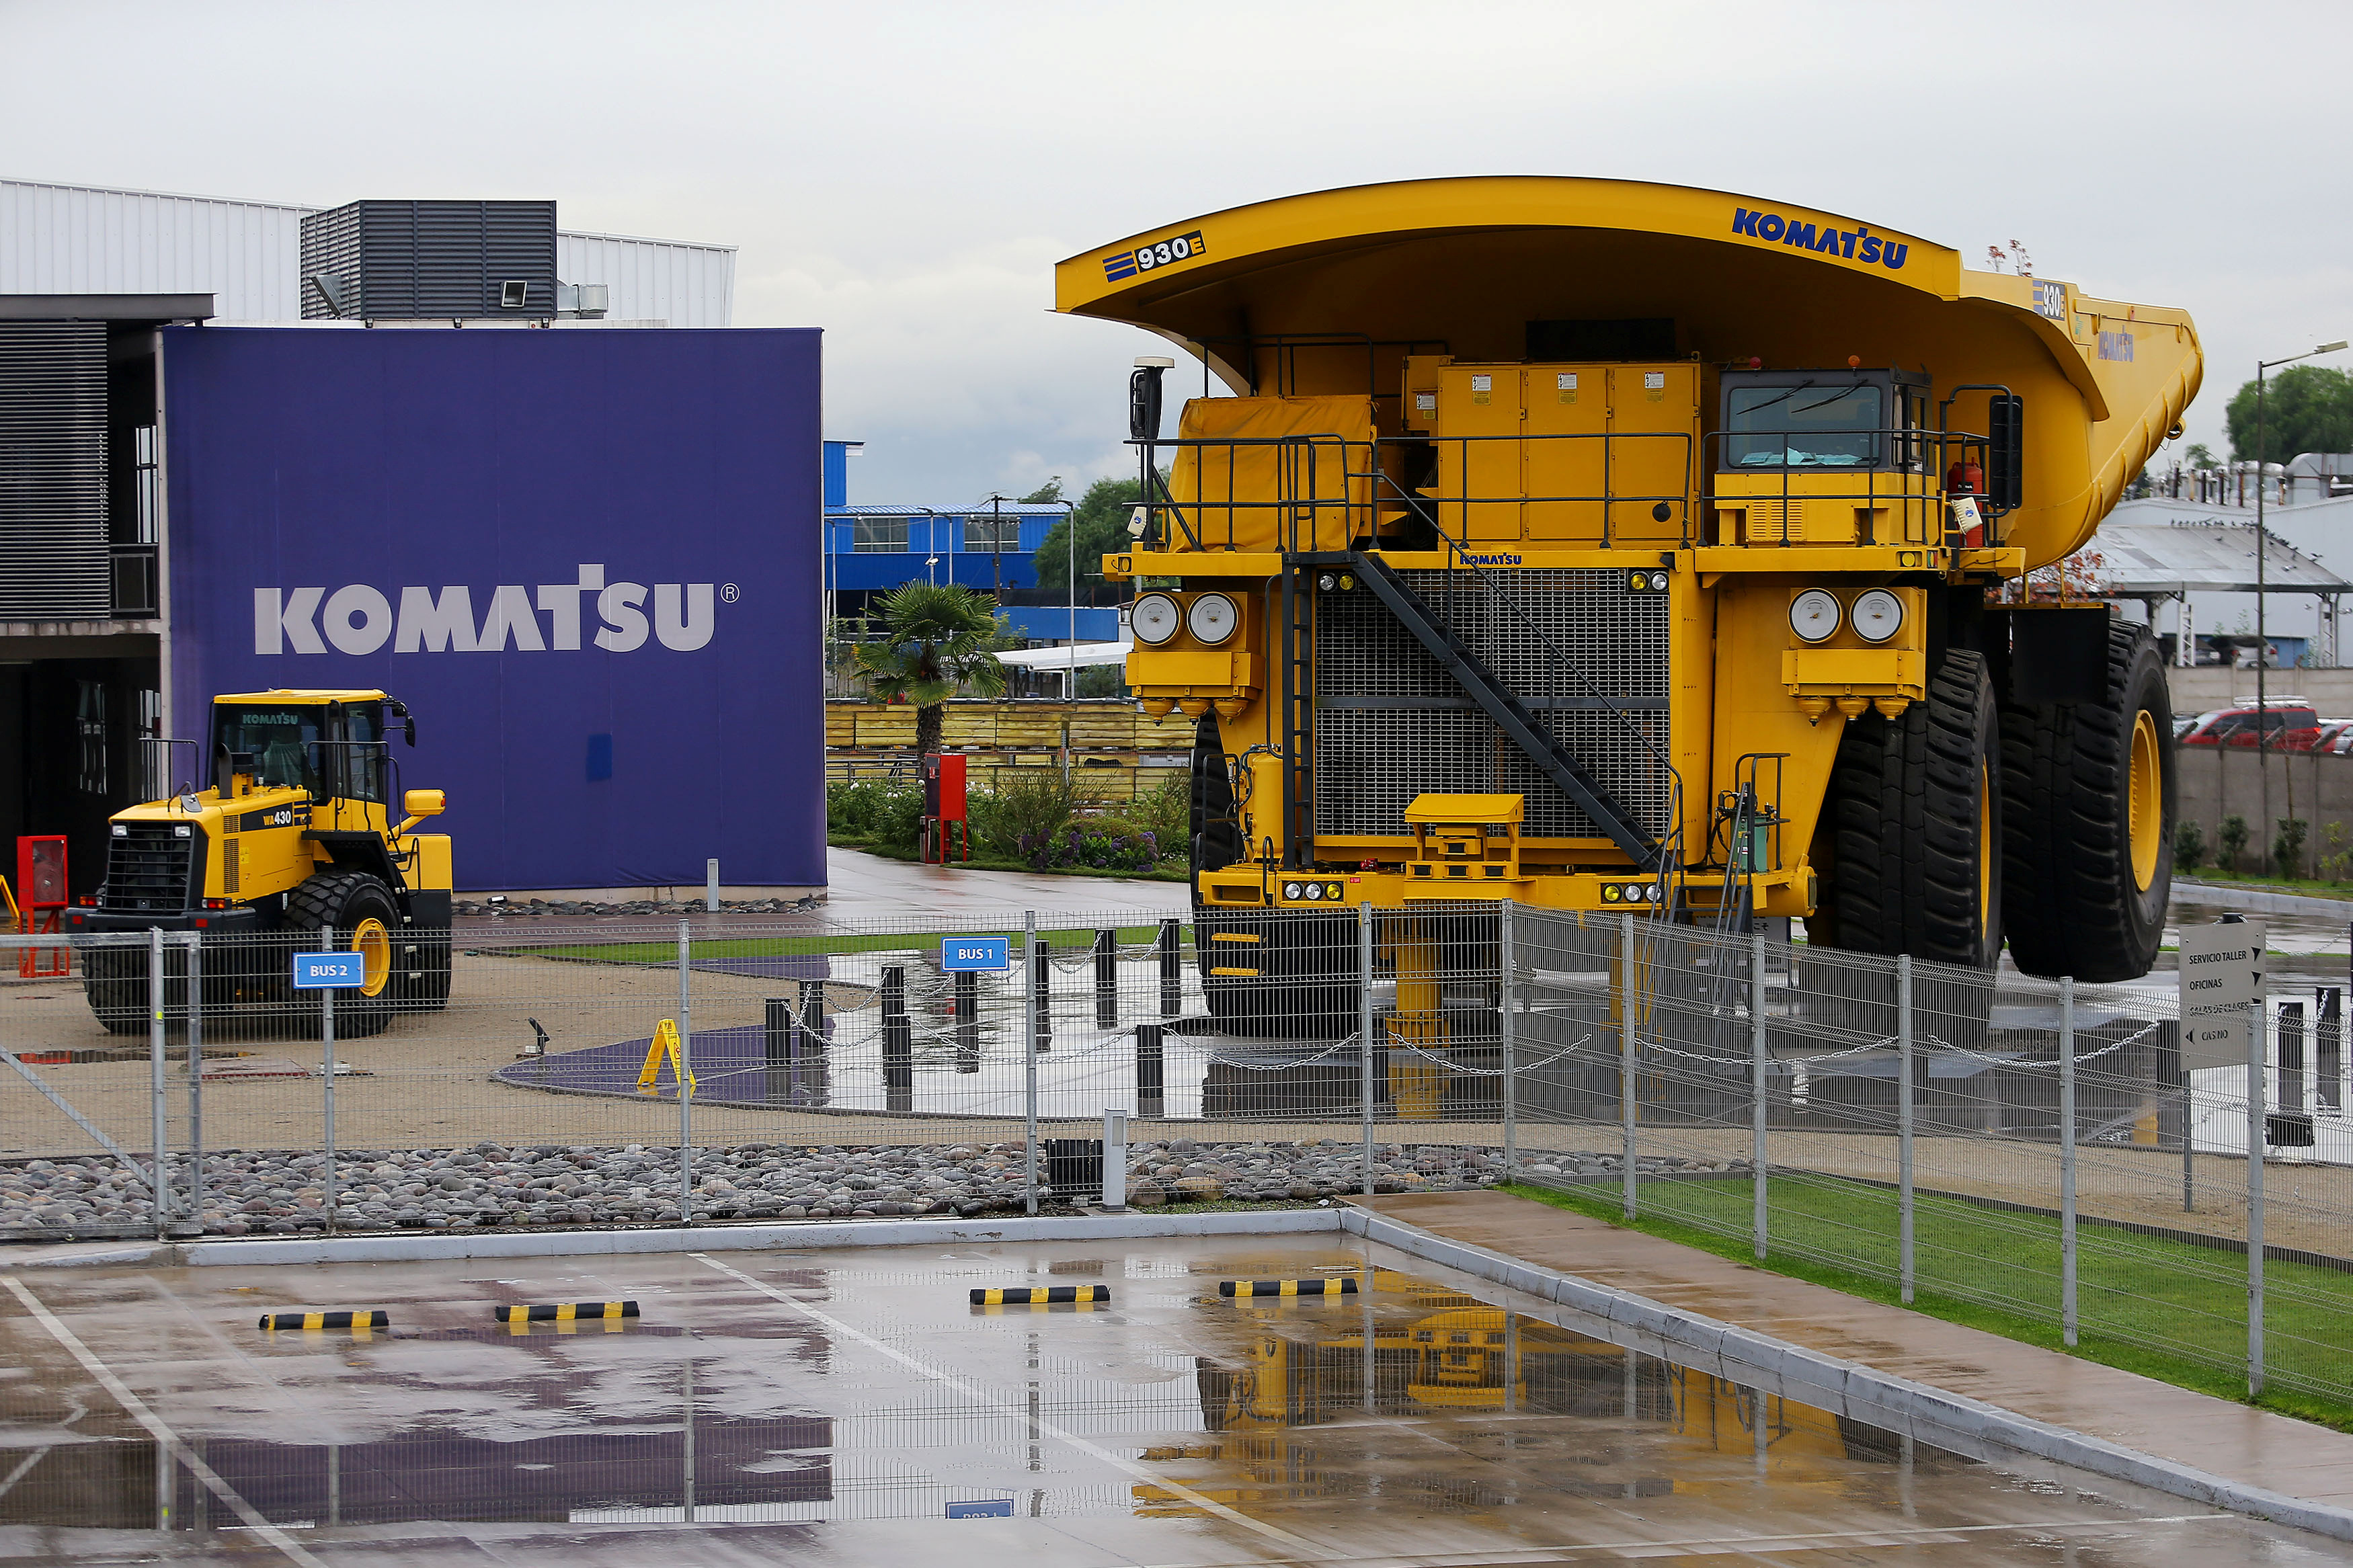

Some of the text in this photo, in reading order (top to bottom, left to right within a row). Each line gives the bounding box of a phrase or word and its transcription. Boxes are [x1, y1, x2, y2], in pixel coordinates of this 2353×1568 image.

[1731, 207, 1909, 270] KOMATSU
[1138, 237, 1205, 270] 930E
[242, 712, 298, 725] KOMATSU
[263, 811, 291, 826] WA430
[958, 948, 993, 960] BUS 1
[2189, 950, 2247, 965] SERVICIO TALLER
[310, 964, 348, 977] BUS 2
[2189, 978, 2223, 991] OFICINAS
[2201, 1029, 2228, 1041] CASNO
